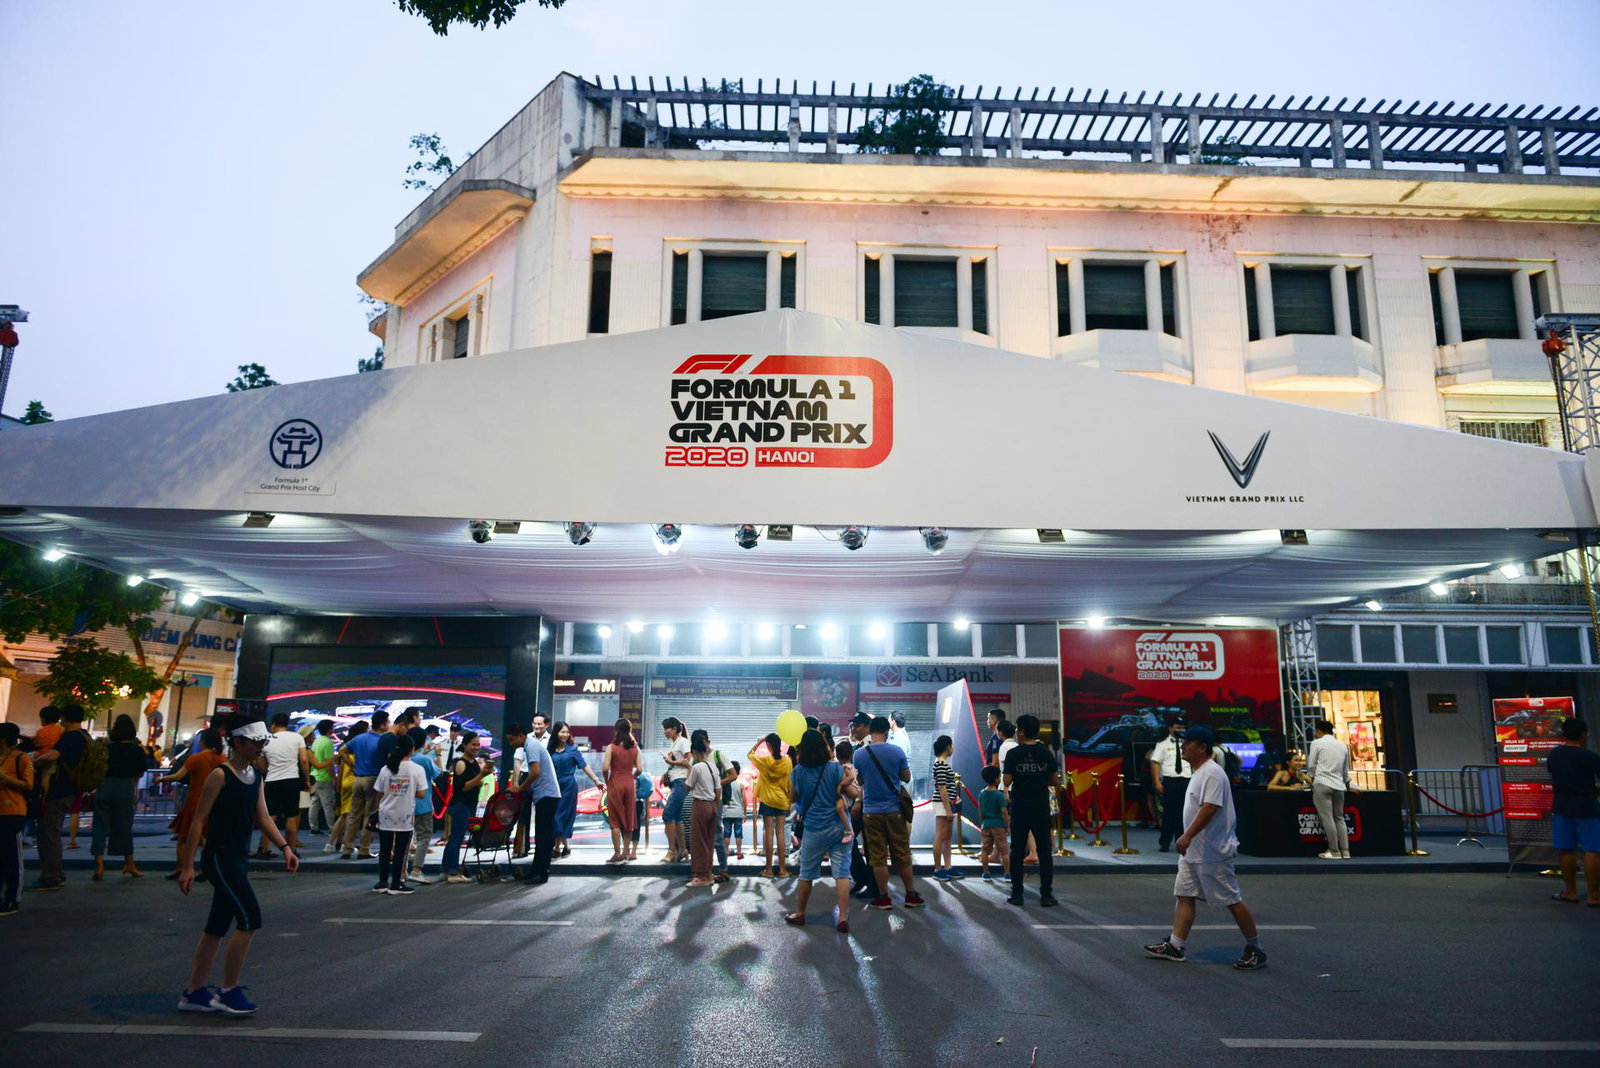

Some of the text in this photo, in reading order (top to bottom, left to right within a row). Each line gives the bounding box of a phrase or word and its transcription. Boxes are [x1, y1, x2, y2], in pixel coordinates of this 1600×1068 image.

[670, 379, 856, 400] FORMULA 1
[670, 400, 828, 421] VIETNAM
[668, 422, 868, 444] GRAND PRIX
[666, 447, 815, 466] 2020 HANOI
[1136, 643, 1209, 651] FORMULA 1
[1136, 652, 1198, 660] VIETNAM
[1136, 661, 1214, 669] GRAND PRIX
[905, 665, 994, 682] SeABank
[1138, 671, 1170, 679] 2020
[582, 679, 616, 692] ATM
